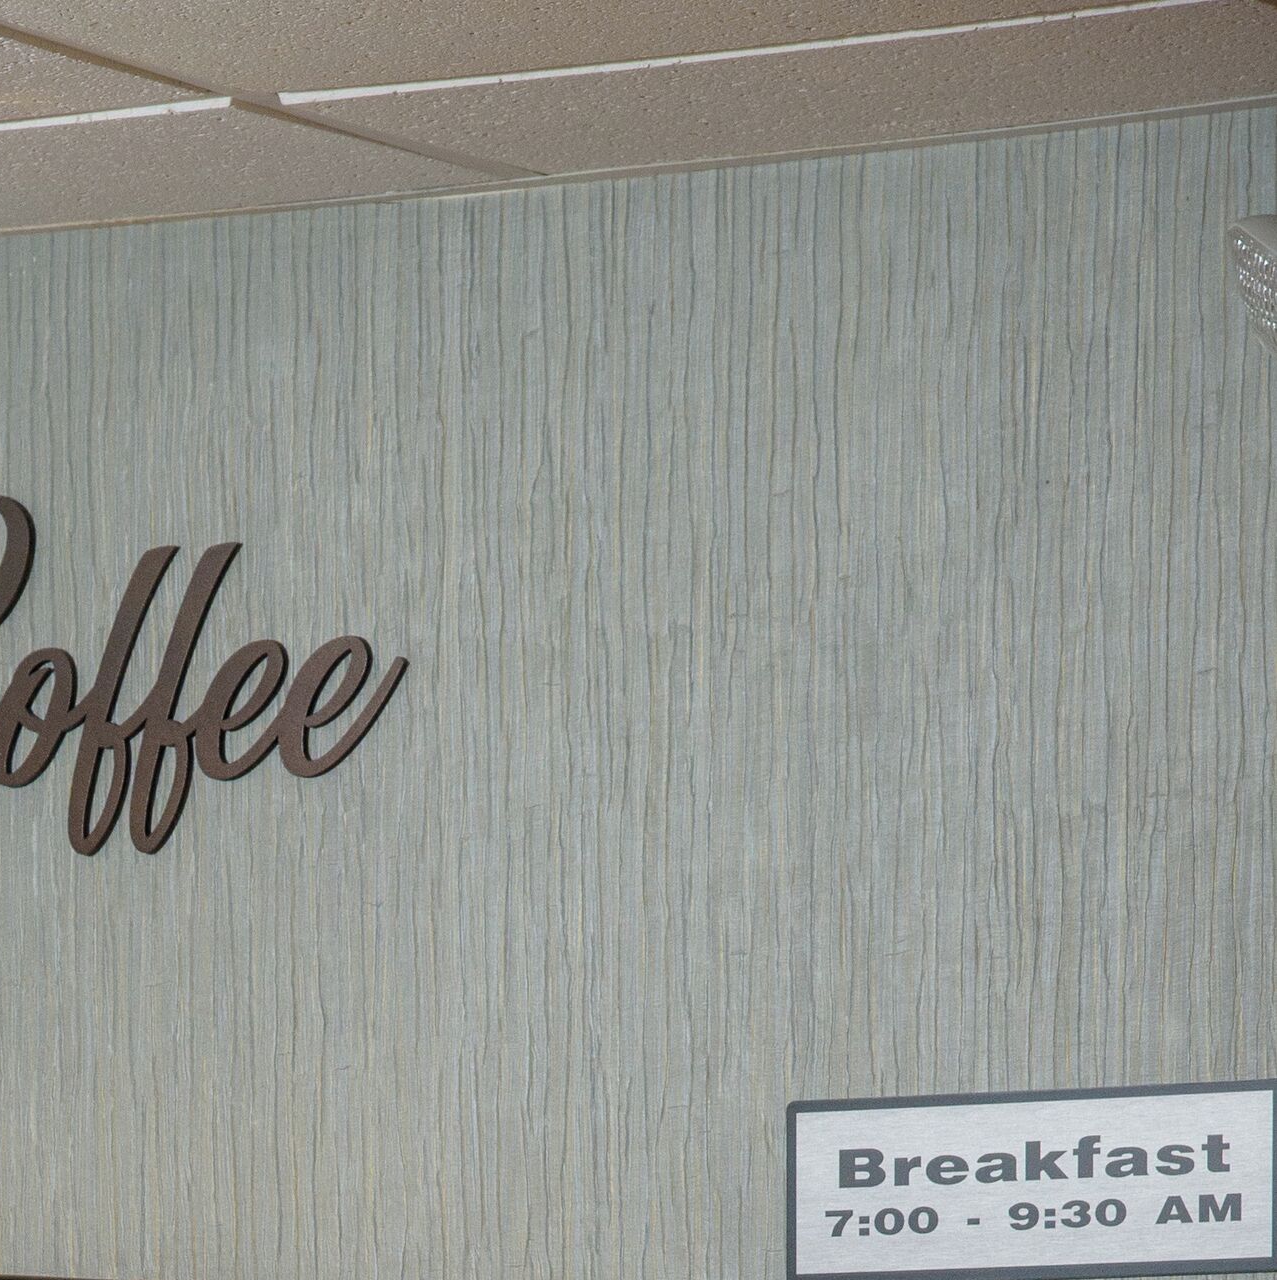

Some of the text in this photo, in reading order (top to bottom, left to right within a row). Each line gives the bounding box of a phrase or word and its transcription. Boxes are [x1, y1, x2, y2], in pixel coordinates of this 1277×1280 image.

[838, 1134, 1231, 1189] Breakfast
[824, 1193, 1242, 1237] 7:00 - 9:30 AM
